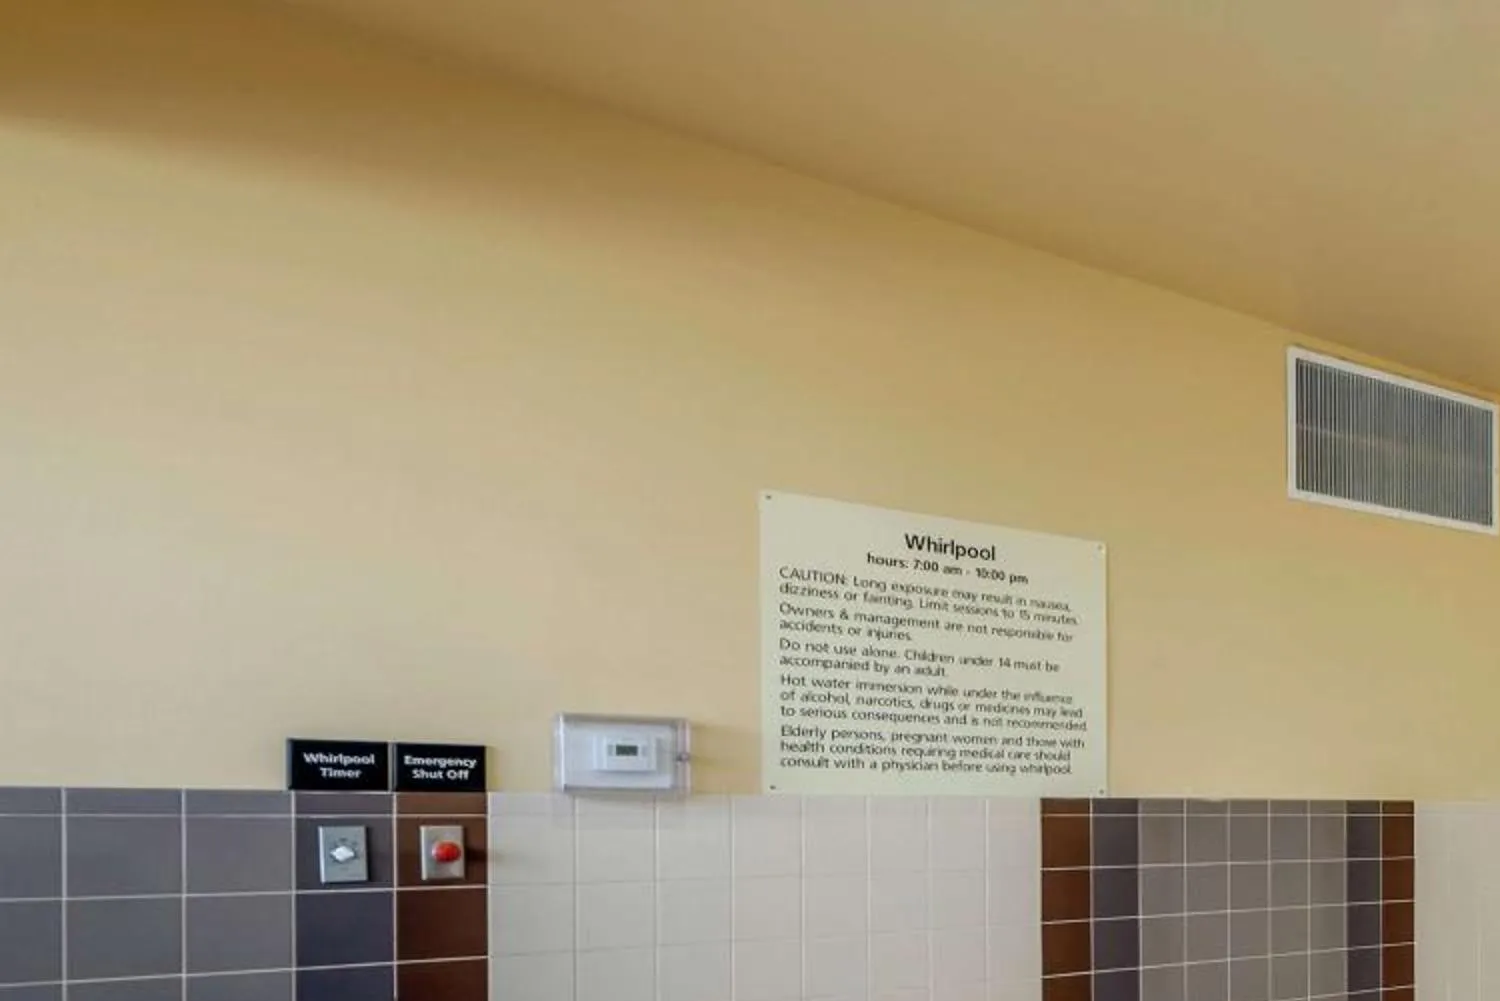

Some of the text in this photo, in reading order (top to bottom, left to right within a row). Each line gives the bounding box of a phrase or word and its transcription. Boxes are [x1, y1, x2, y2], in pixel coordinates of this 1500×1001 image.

[904, 533, 995, 561] Whirlpool
[867, 552, 909, 569] hours:
[914, 559, 939, 571] 7:00
[943, 565, 962, 576] am
[976, 568, 1005, 581] 10:00
[1009, 574, 1028, 585] pm
[779, 583, 839, 599] dizziness
[844, 592, 857, 600] or
[919, 599, 949, 612] Limit
[953, 604, 999, 617] sessions
[1002, 609, 1014, 618] to
[1019, 610, 1030, 620] 15
[853, 576, 887, 592] Long
[891, 583, 949, 597] exposure
[952, 589, 976, 602] may
[981, 592, 1013, 605] result
[1016, 597, 1027, 606] in
[779, 602, 1073, 642] Owners & management are not responsible for
[779, 620, 843, 635] accidents
[848, 628, 862, 636] or
[779, 637, 800, 651] Do
[805, 643, 829, 653] not
[834, 645, 856, 655] use
[904, 649, 954, 664] Children
[959, 656, 993, 666] under
[999, 658, 1011, 667] 14
[1014, 659, 1041, 671] must
[1045, 660, 1060, 672] be
[780, 655, 869, 671] accompanied
[874, 660, 890, 675] by
[894, 665, 910, 674] an
[781, 674, 1073, 704] Hot water immersion while under the influence
[780, 691, 795, 701] of
[920, 698, 954, 712] drugs
[958, 702, 970, 711] or
[976, 703, 1030, 715] medicines
[1033, 707, 1056, 718] may
[1060, 707, 1083, 718] lead
[781, 705, 796, 717] to
[800, 707, 847, 719] serious
[852, 710, 940, 724] consequences
[944, 715, 967, 725] and
[971, 717, 979, 726] is
[983, 717, 1002, 726] not
[781, 724, 827, 739] Elderly
[891, 731, 947, 744] pregnant
[952, 735, 997, 744] women
[1001, 736, 1023, 746] and
[1026, 736, 1057, 747] those
[1060, 739, 1085, 749] with
[303, 752, 375, 766] Whirlpool
[403, 755, 477, 769] Emergency
[781, 740, 1071, 761] health conditions requiring medical care should
[319, 767, 362, 779] Timer
[412, 769, 469, 780] Shut Off
[780, 756, 829, 769] consult
[834, 758, 865, 769] with
[869, 761, 877, 769] a
[882, 758, 938, 772] physician
[942, 760, 982, 773] before
[986, 763, 1016, 776] using
